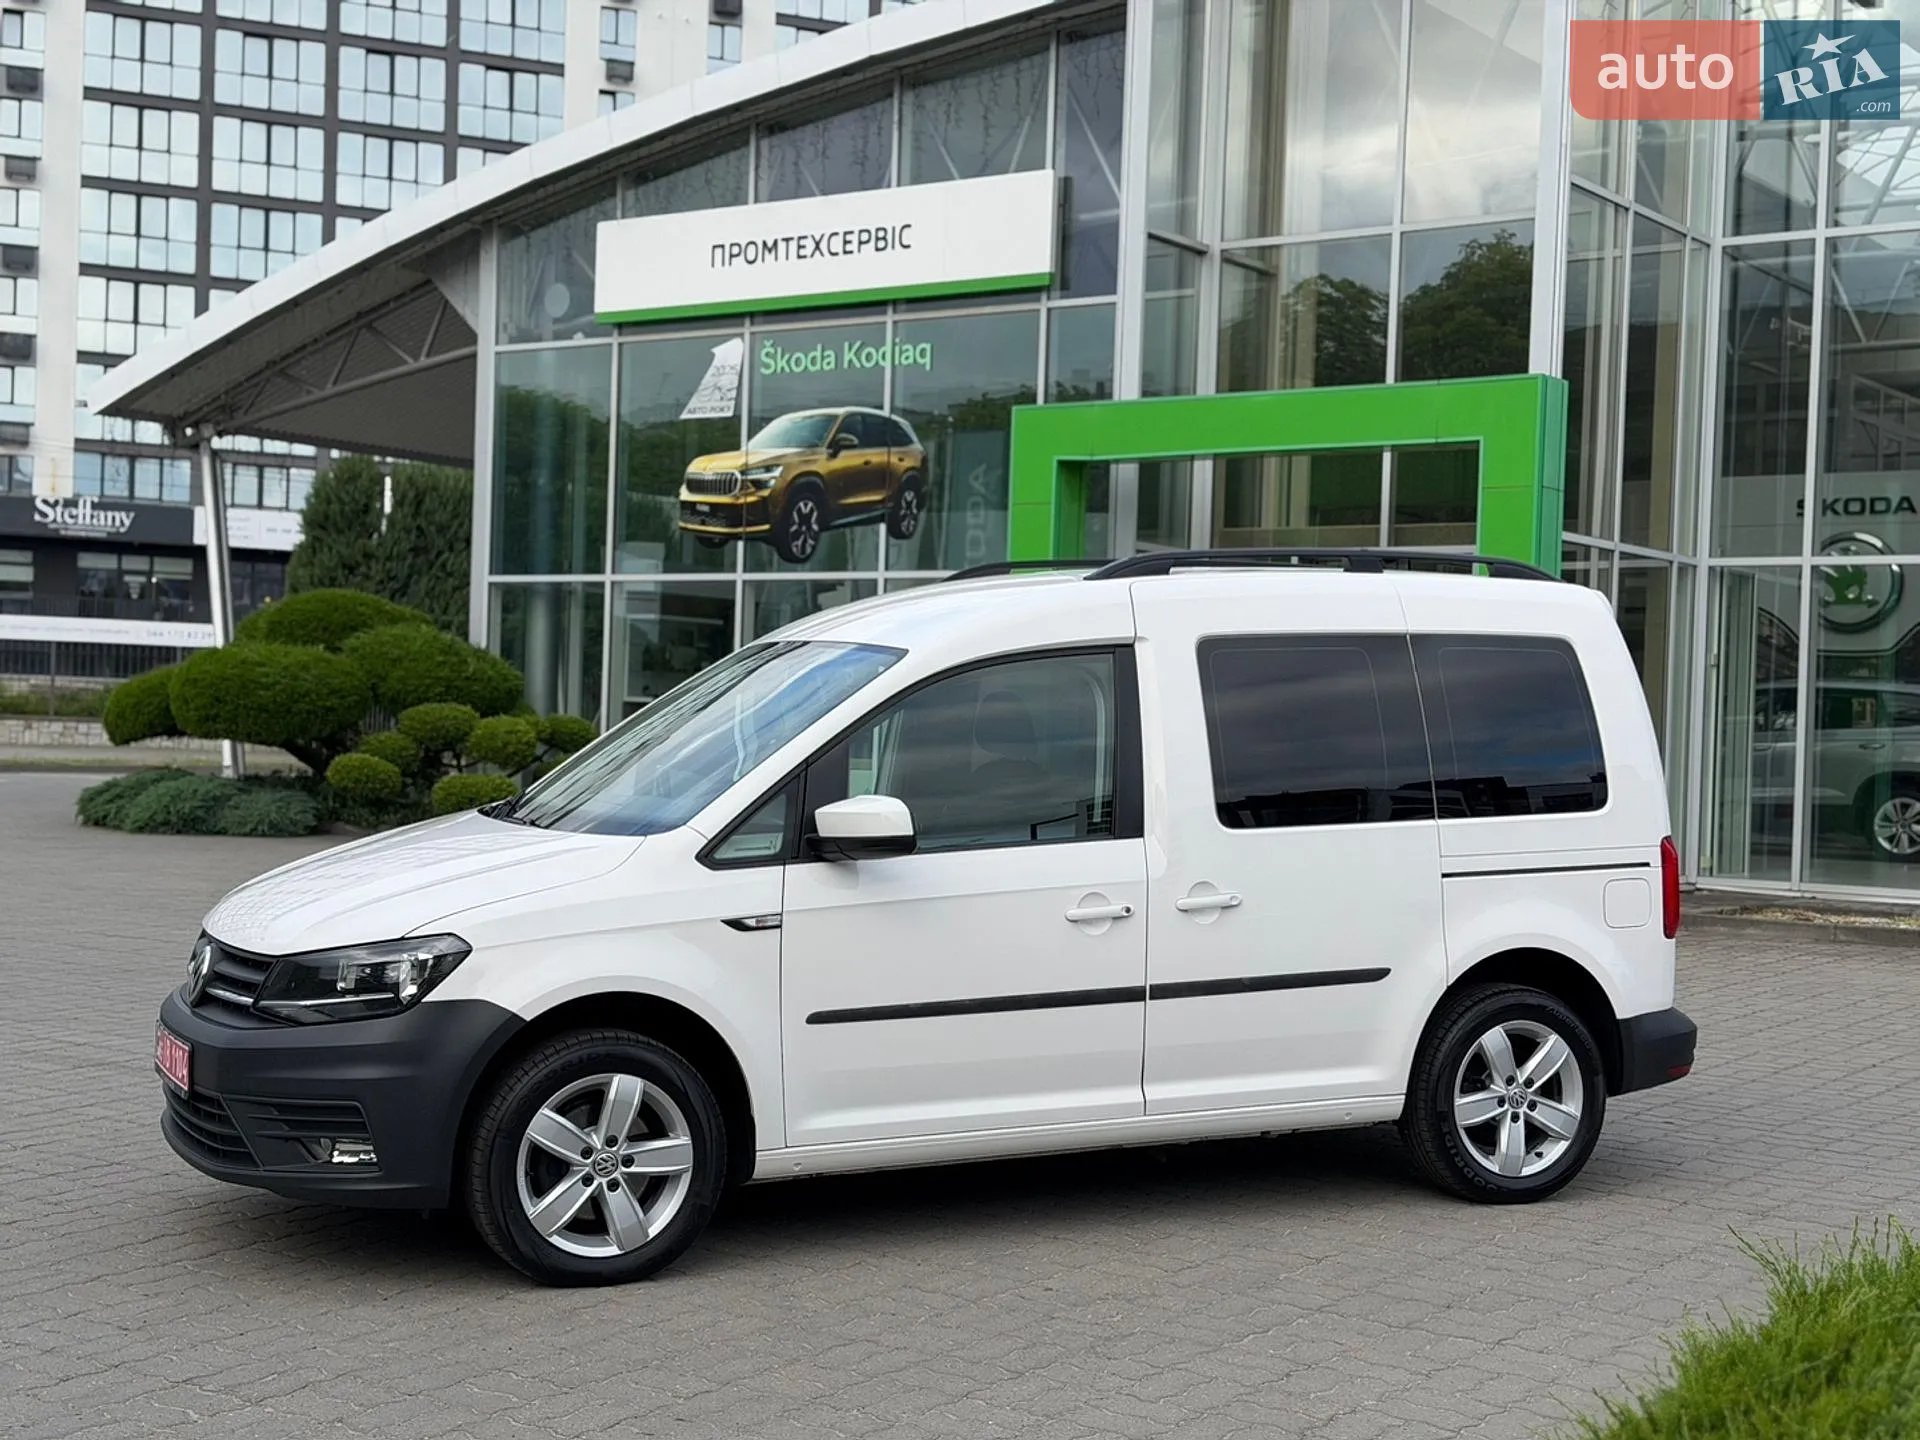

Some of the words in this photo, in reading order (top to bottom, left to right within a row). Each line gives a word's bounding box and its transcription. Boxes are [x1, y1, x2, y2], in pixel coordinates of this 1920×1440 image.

[711, 223, 912, 268] ПРОМТЕХСЕРВІС
[760, 339, 836, 375] Škoda
[843, 338, 932, 371] Kodiaq
